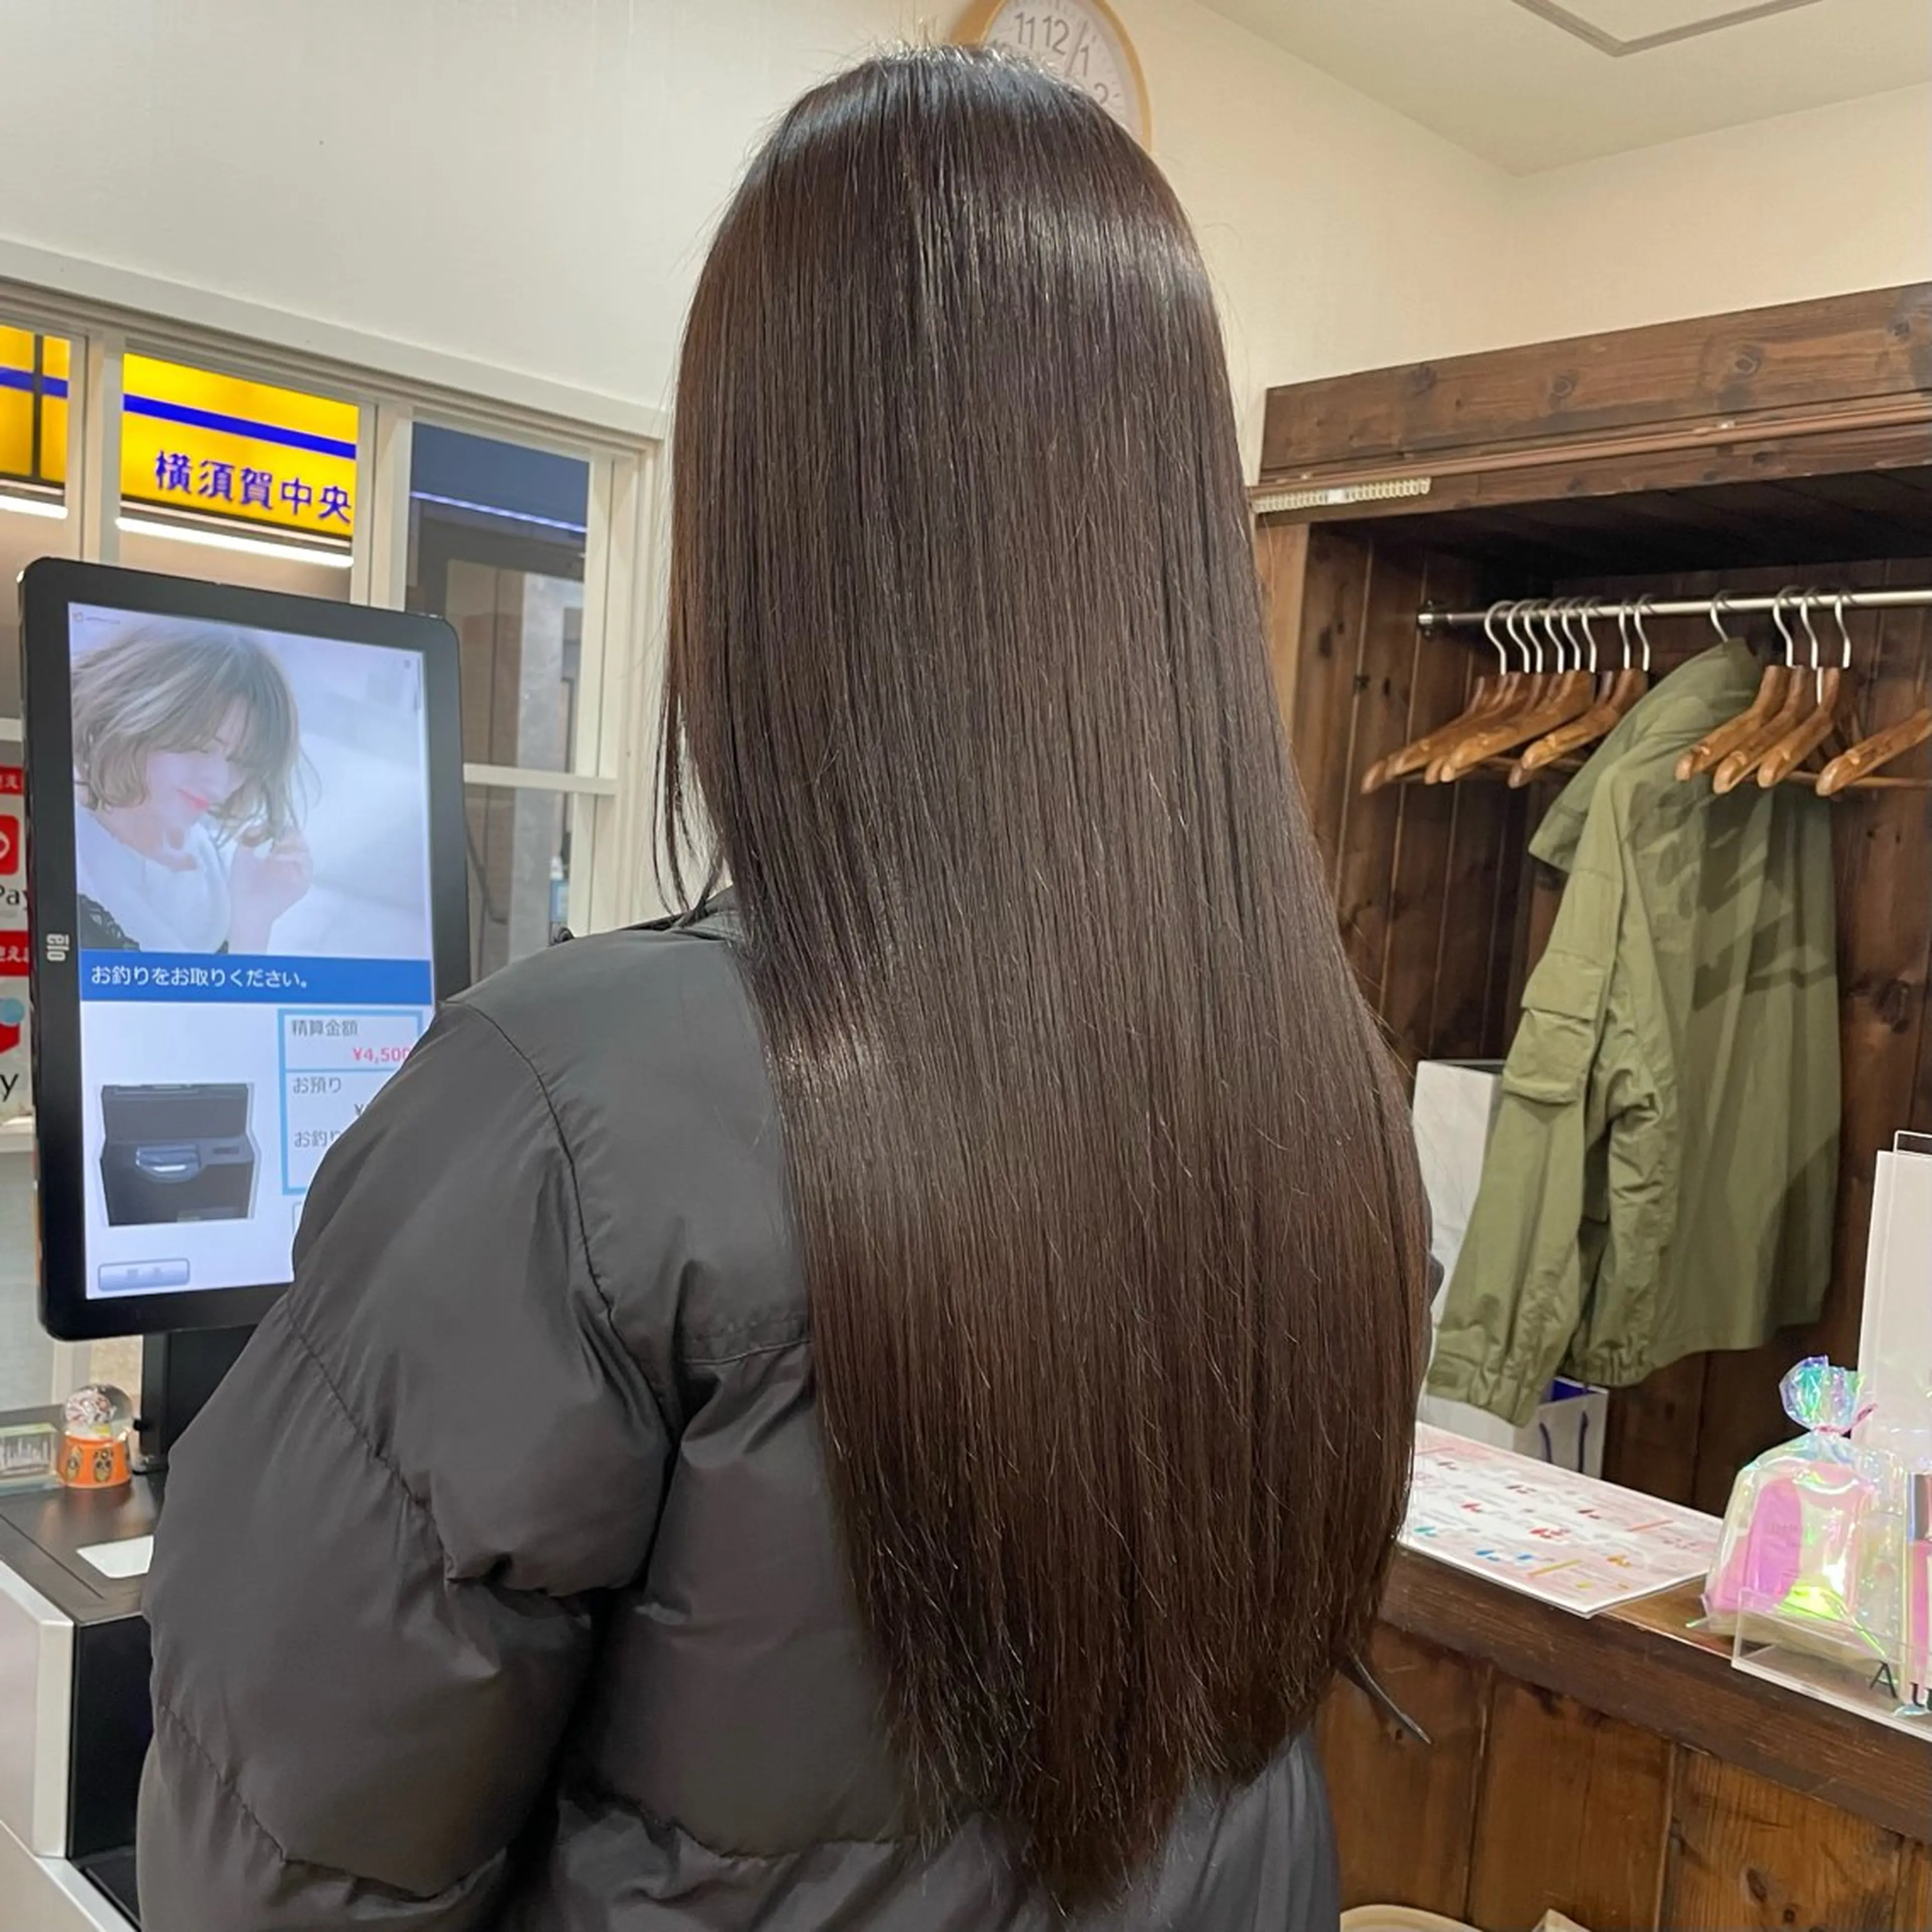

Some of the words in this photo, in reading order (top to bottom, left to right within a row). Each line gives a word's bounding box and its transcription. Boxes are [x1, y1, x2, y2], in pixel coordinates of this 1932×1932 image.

[1014, 12, 1035, 49] 11
[1042, 15, 1069, 55] 12
[1079, 45, 1090, 77] 1
[155, 450, 351, 524] 横須賀中央
[91, 965, 307, 989] お釣りをお取りください。
[291, 1019, 358, 1036] 精算金額
[293, 1076, 342, 1094] お預り
